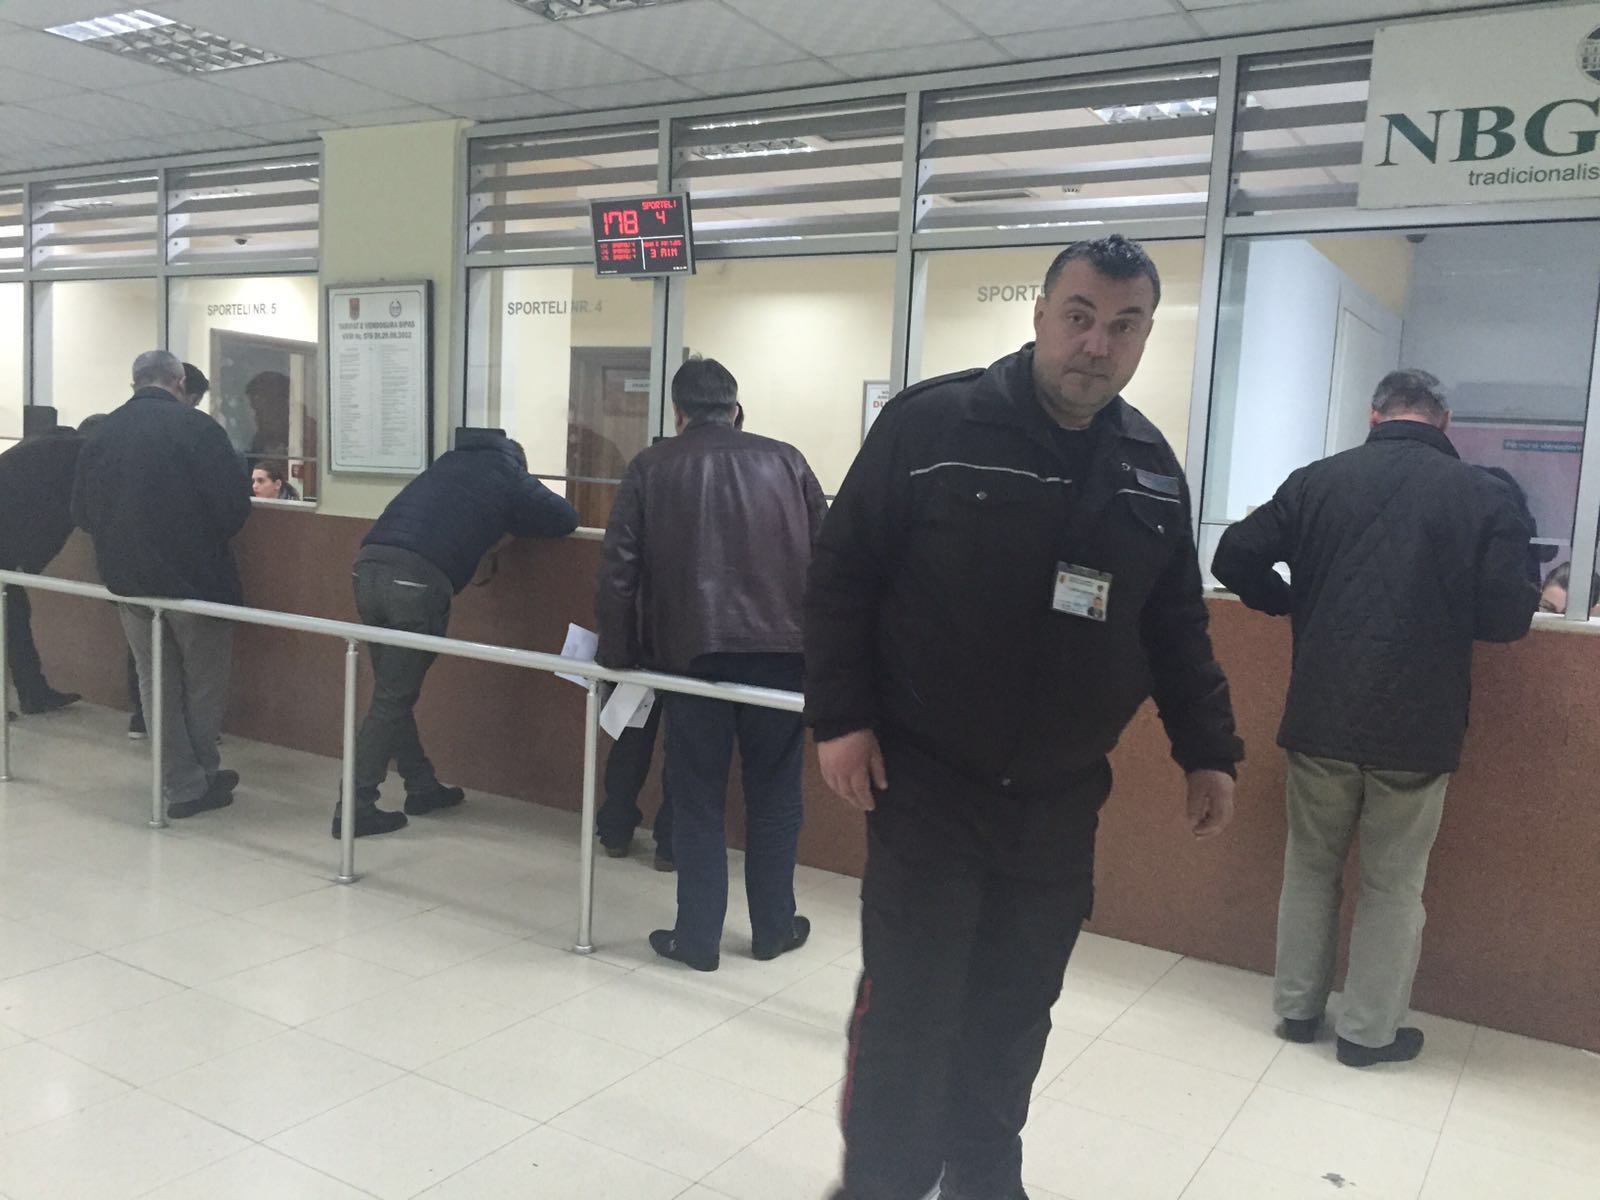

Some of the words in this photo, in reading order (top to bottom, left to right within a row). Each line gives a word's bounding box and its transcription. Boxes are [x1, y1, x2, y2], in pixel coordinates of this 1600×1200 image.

[1375, 98, 1600, 167] NBG
[641, 199, 677, 211] SPORTELI
[603, 209, 639, 236] 178
[655, 210, 667, 225] 4
[650, 248, 657, 258] 3
[977, 285, 1045, 302] SPORT
[207, 303, 251, 316] SPORTELI
[271, 302, 277, 314] 5
[507, 300, 567, 315] SPORTELI
[594, 299, 602, 313] 4
